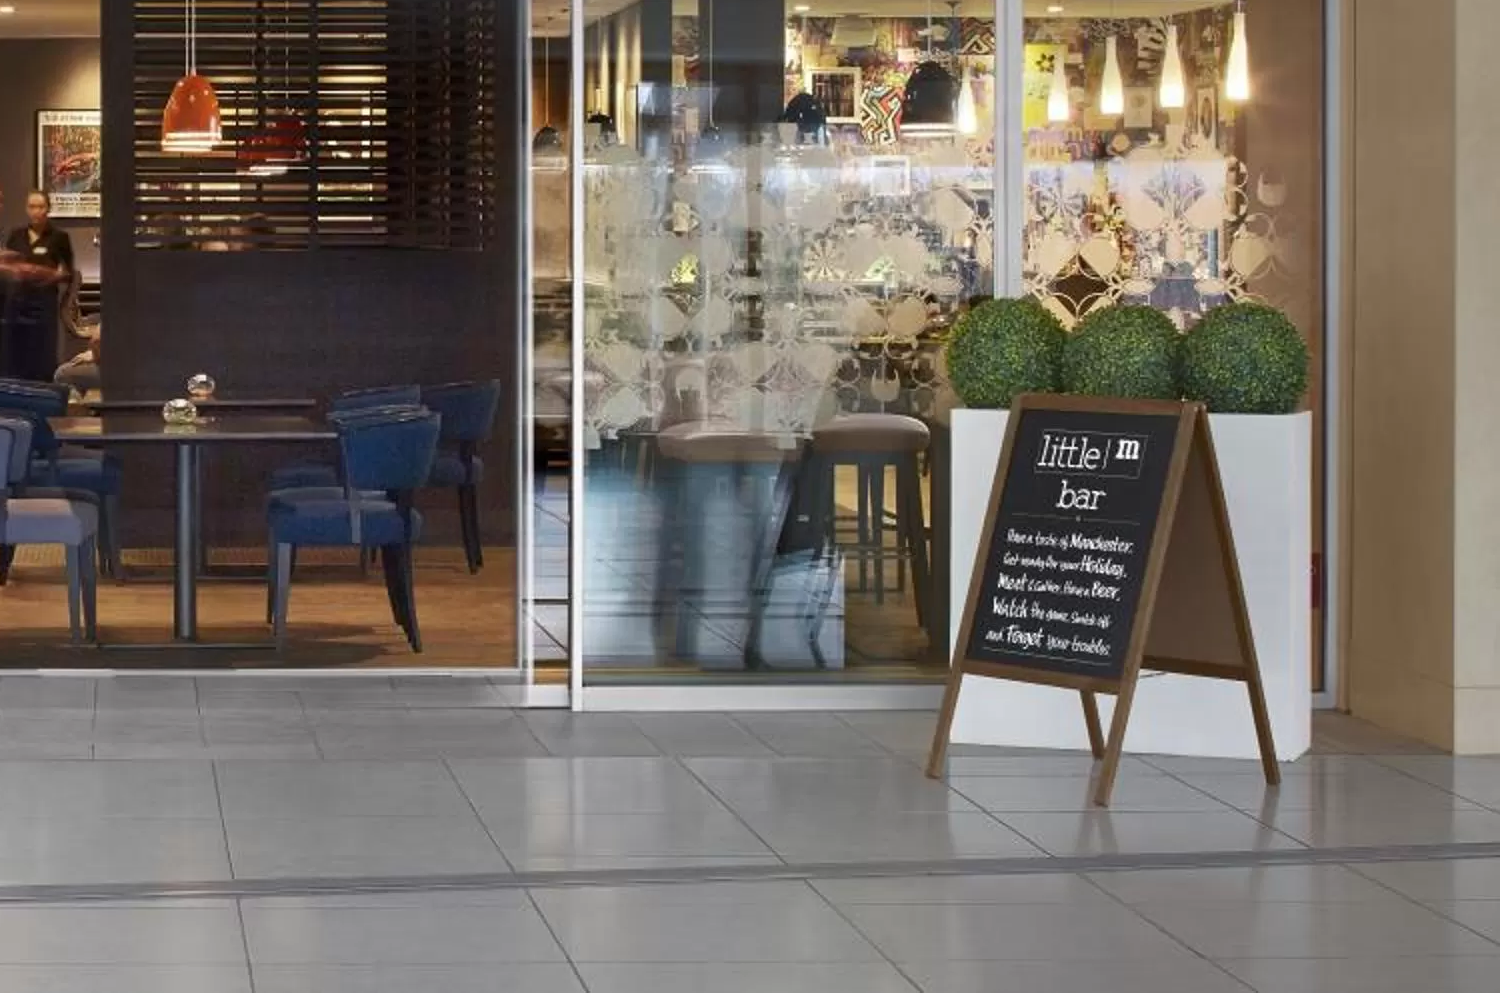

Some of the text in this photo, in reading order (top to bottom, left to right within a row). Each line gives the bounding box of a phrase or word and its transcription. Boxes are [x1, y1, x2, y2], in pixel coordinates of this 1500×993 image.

[1037, 434, 1140, 469] little m
[1056, 480, 1106, 510] bar
